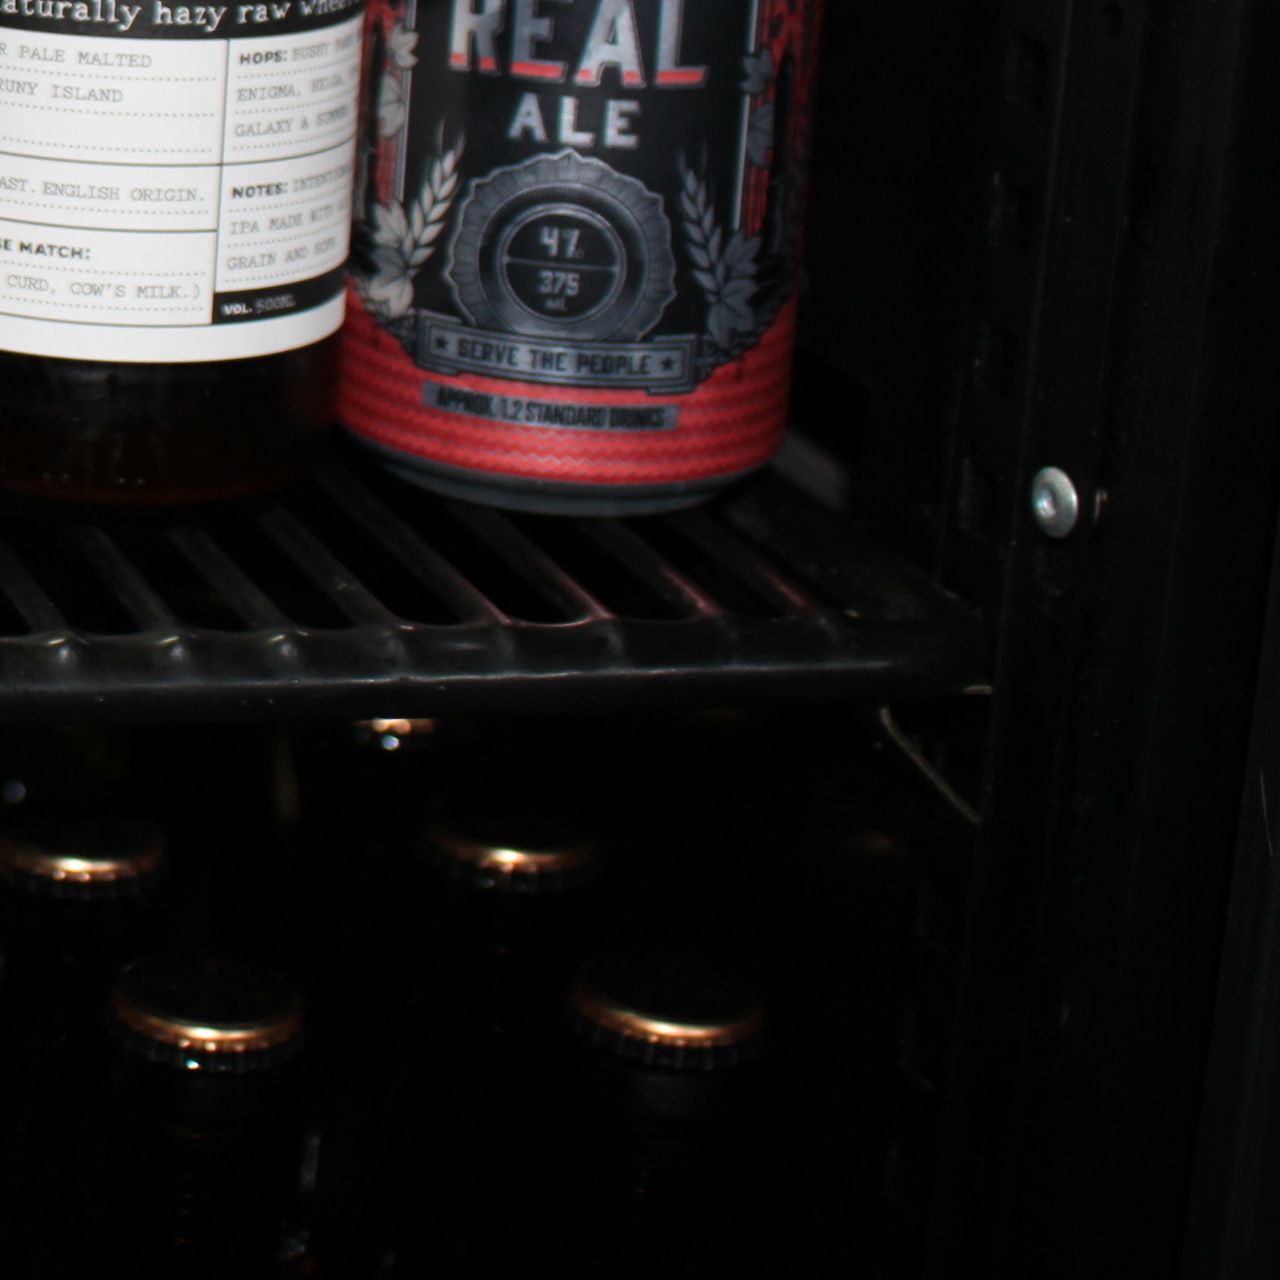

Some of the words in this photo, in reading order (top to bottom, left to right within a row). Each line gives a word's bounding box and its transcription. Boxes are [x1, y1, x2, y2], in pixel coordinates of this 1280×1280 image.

[152, 0, 227, 32] hazy
[237, 1, 292, 24] raw
[19, 44, 66, 64] PALE
[78, 51, 153, 68] MALTED
[240, 49, 288, 65] HOPS:
[51, 85, 124, 103] ISLAND
[235, 119, 295, 137] GALAXY
[508, 91, 641, 149] ALE
[43, 181, 121, 200] ENGLISH
[131, 188, 205, 203] ORIGIN.
[231, 181, 288, 199] NOTES:
[230, 221, 260, 236] IPA
[20, 242, 91, 260] MATCH:
[227, 253, 278, 271] GRAIN
[71, 282, 126, 299] COW'S
[539, 270, 580, 297] 375
[458, 337, 519, 367] SERVE
[529, 348, 567, 371] THE
[577, 353, 652, 375] PEOPLE
